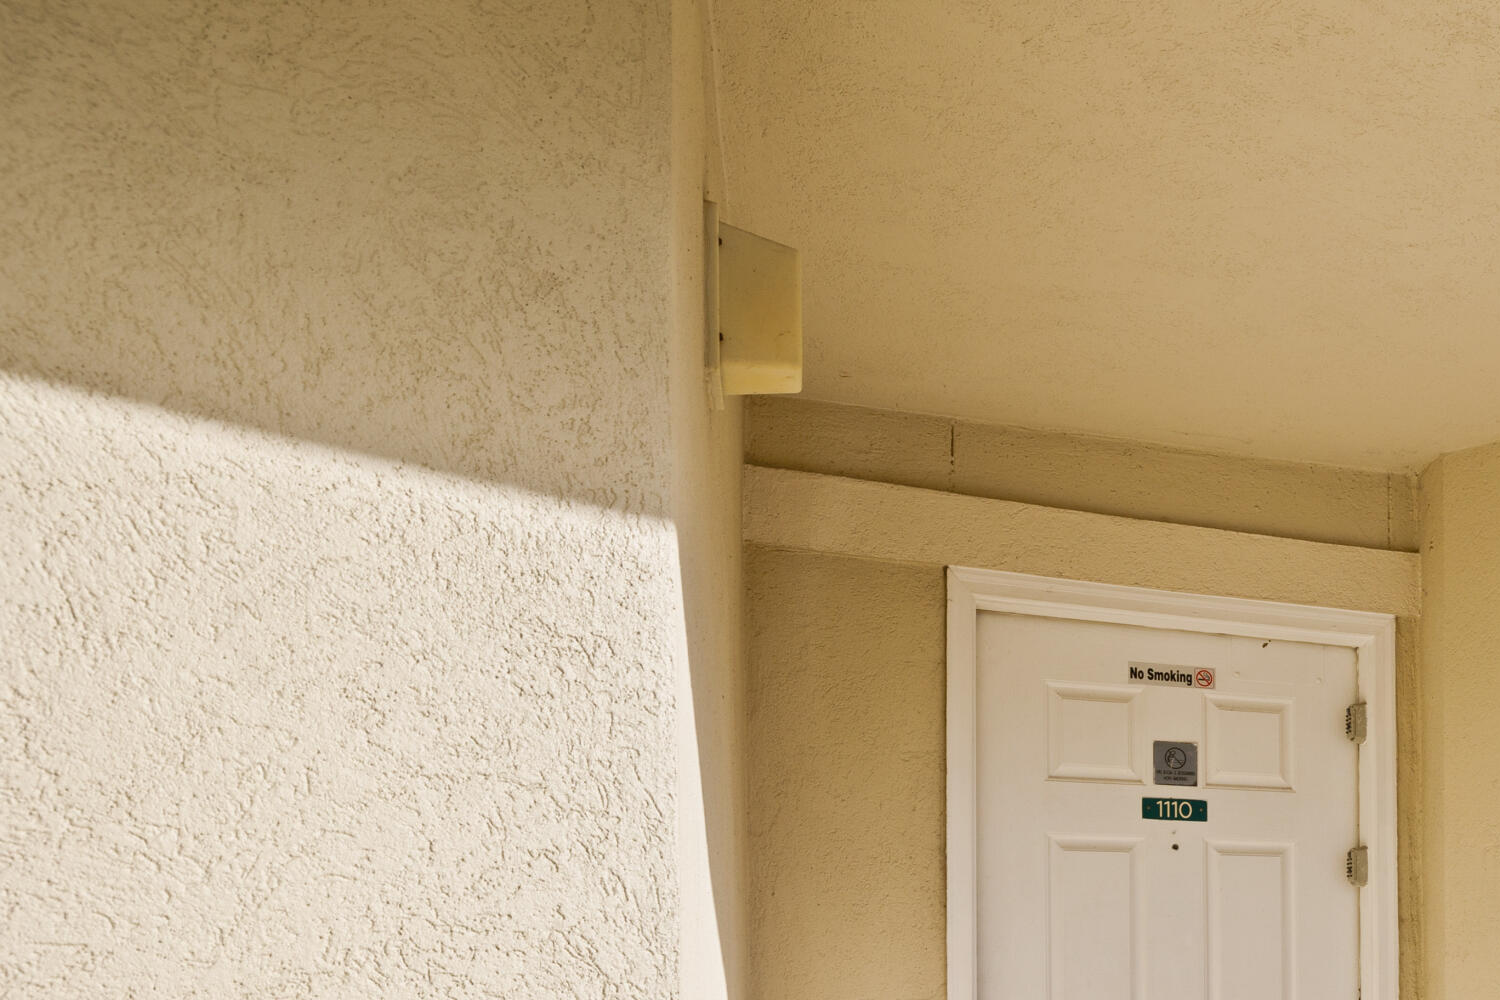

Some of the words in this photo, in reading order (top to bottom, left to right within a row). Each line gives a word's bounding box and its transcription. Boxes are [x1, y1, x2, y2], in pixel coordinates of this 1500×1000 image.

[1130, 667, 1144, 680] No
[1147, 668, 1193, 686] Smoking
[1156, 800, 1193, 819] 1110
